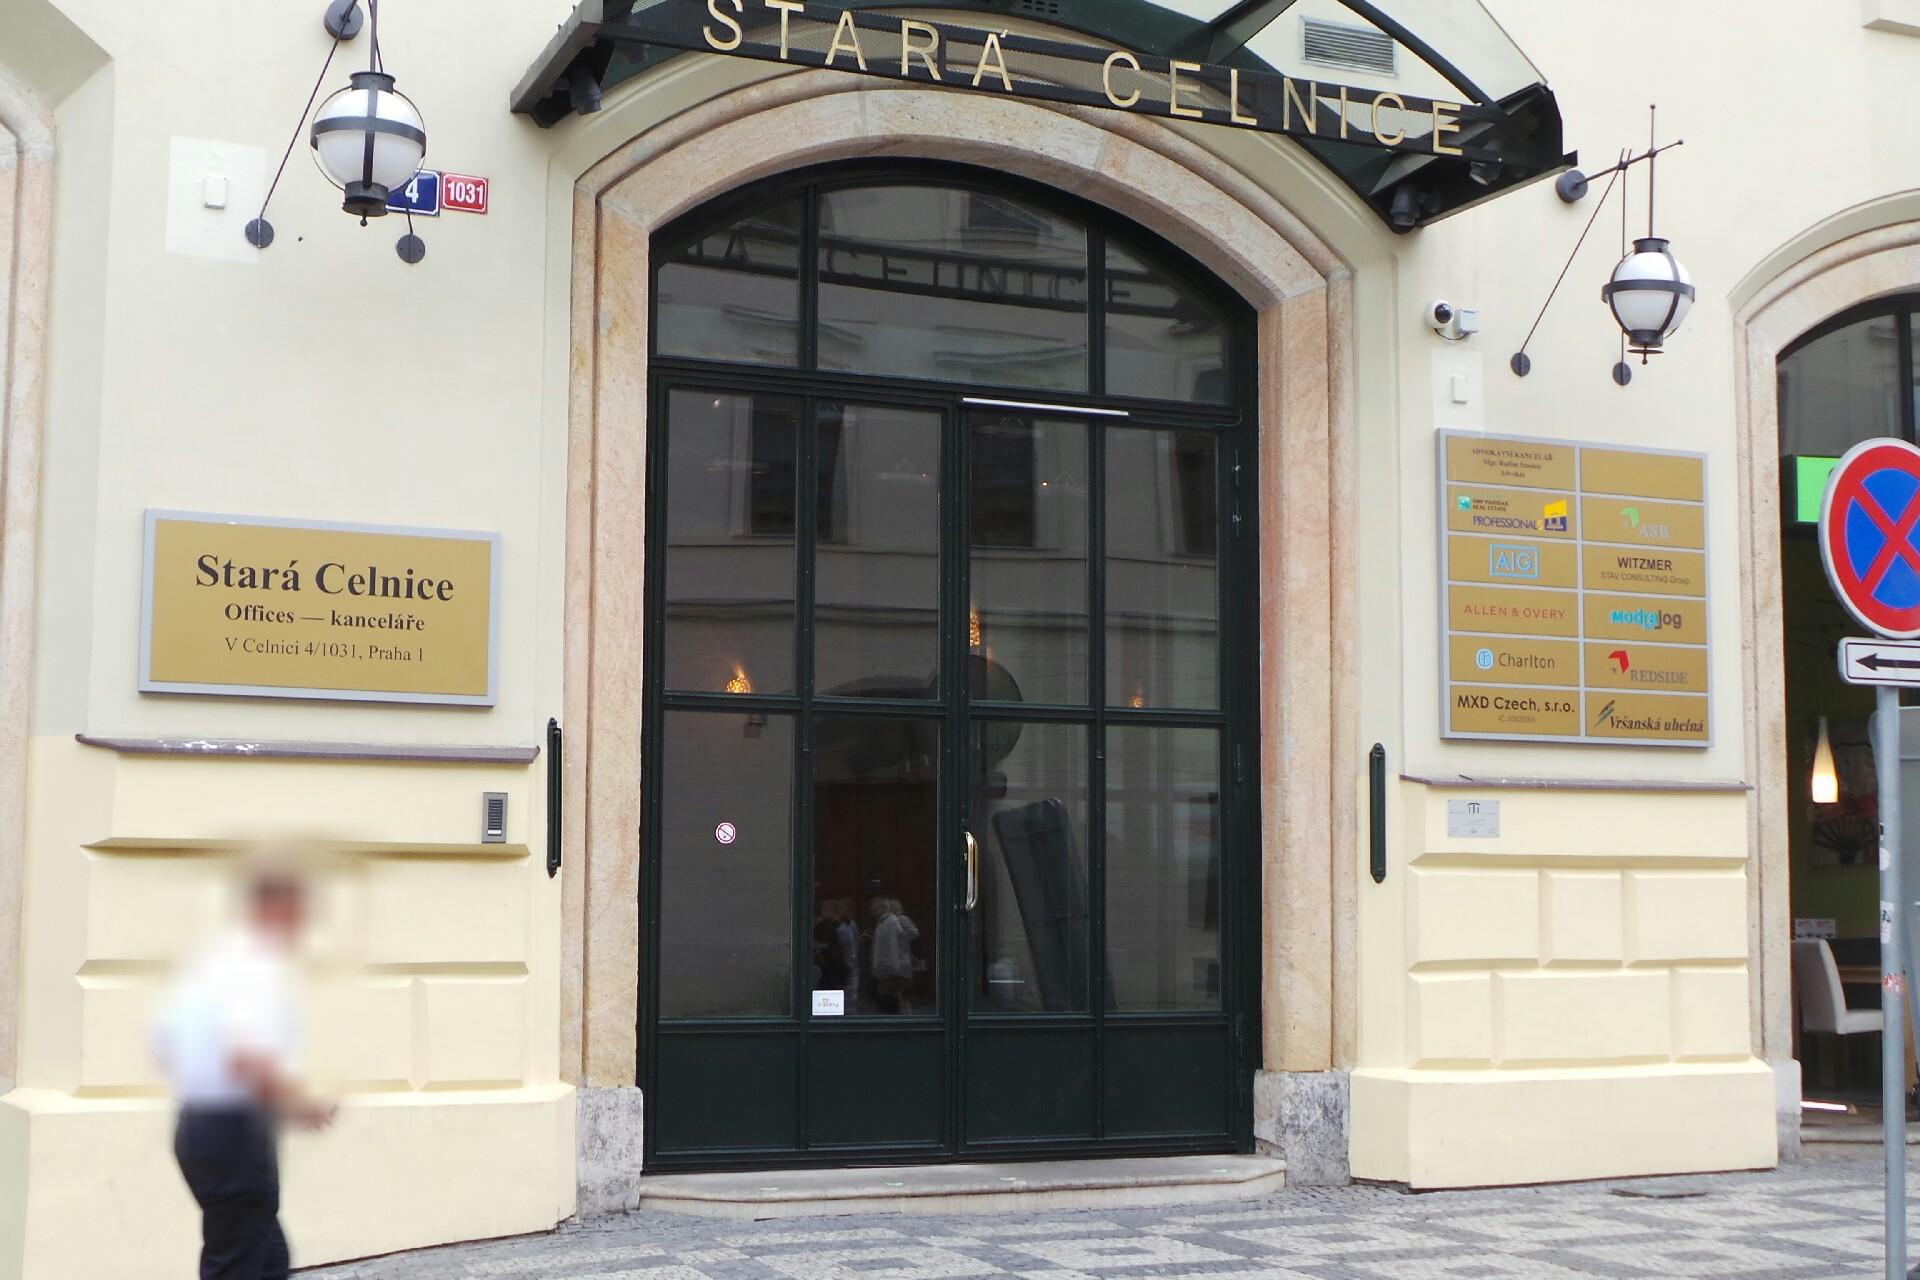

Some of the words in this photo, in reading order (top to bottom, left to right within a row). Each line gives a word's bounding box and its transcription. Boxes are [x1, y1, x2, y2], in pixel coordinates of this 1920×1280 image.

[702, 0, 1012, 91] STARÁ
[1102, 51, 1463, 156] CELNICE
[404, 177, 419, 204] 4
[447, 181, 483, 204] 1031
[1472, 515, 1544, 534] PROFESSIONALS
[1495, 551, 1533, 572] AIG
[1617, 556, 1673, 572] WITZMER
[195, 553, 301, 592] Stará
[314, 562, 455, 602] Celnice
[1621, 572, 1668, 584] CONSULTING
[224, 602, 295, 624] Offices
[330, 609, 426, 632] kanceláře
[1464, 604, 1507, 616] ALLEN
[1511, 608, 1520, 616] &
[1522, 608, 1566, 620] OVERY
[224, 636, 238, 652] V
[243, 638, 300, 656] Celnici
[304, 640, 363, 661] 4/1031,
[368, 644, 412, 662] Praha
[418, 647, 424, 662] 1
[1498, 652, 1555, 669] Charlton
[1630, 670, 1688, 684] REDSIDE
[1457, 694, 1489, 709] MXD
[1494, 696, 1541, 712] Czech,
[1544, 701, 1575, 713] s.r.o.
[1610, 715, 1660, 730] Vršanská
[1664, 717, 1704, 732] uhelná
